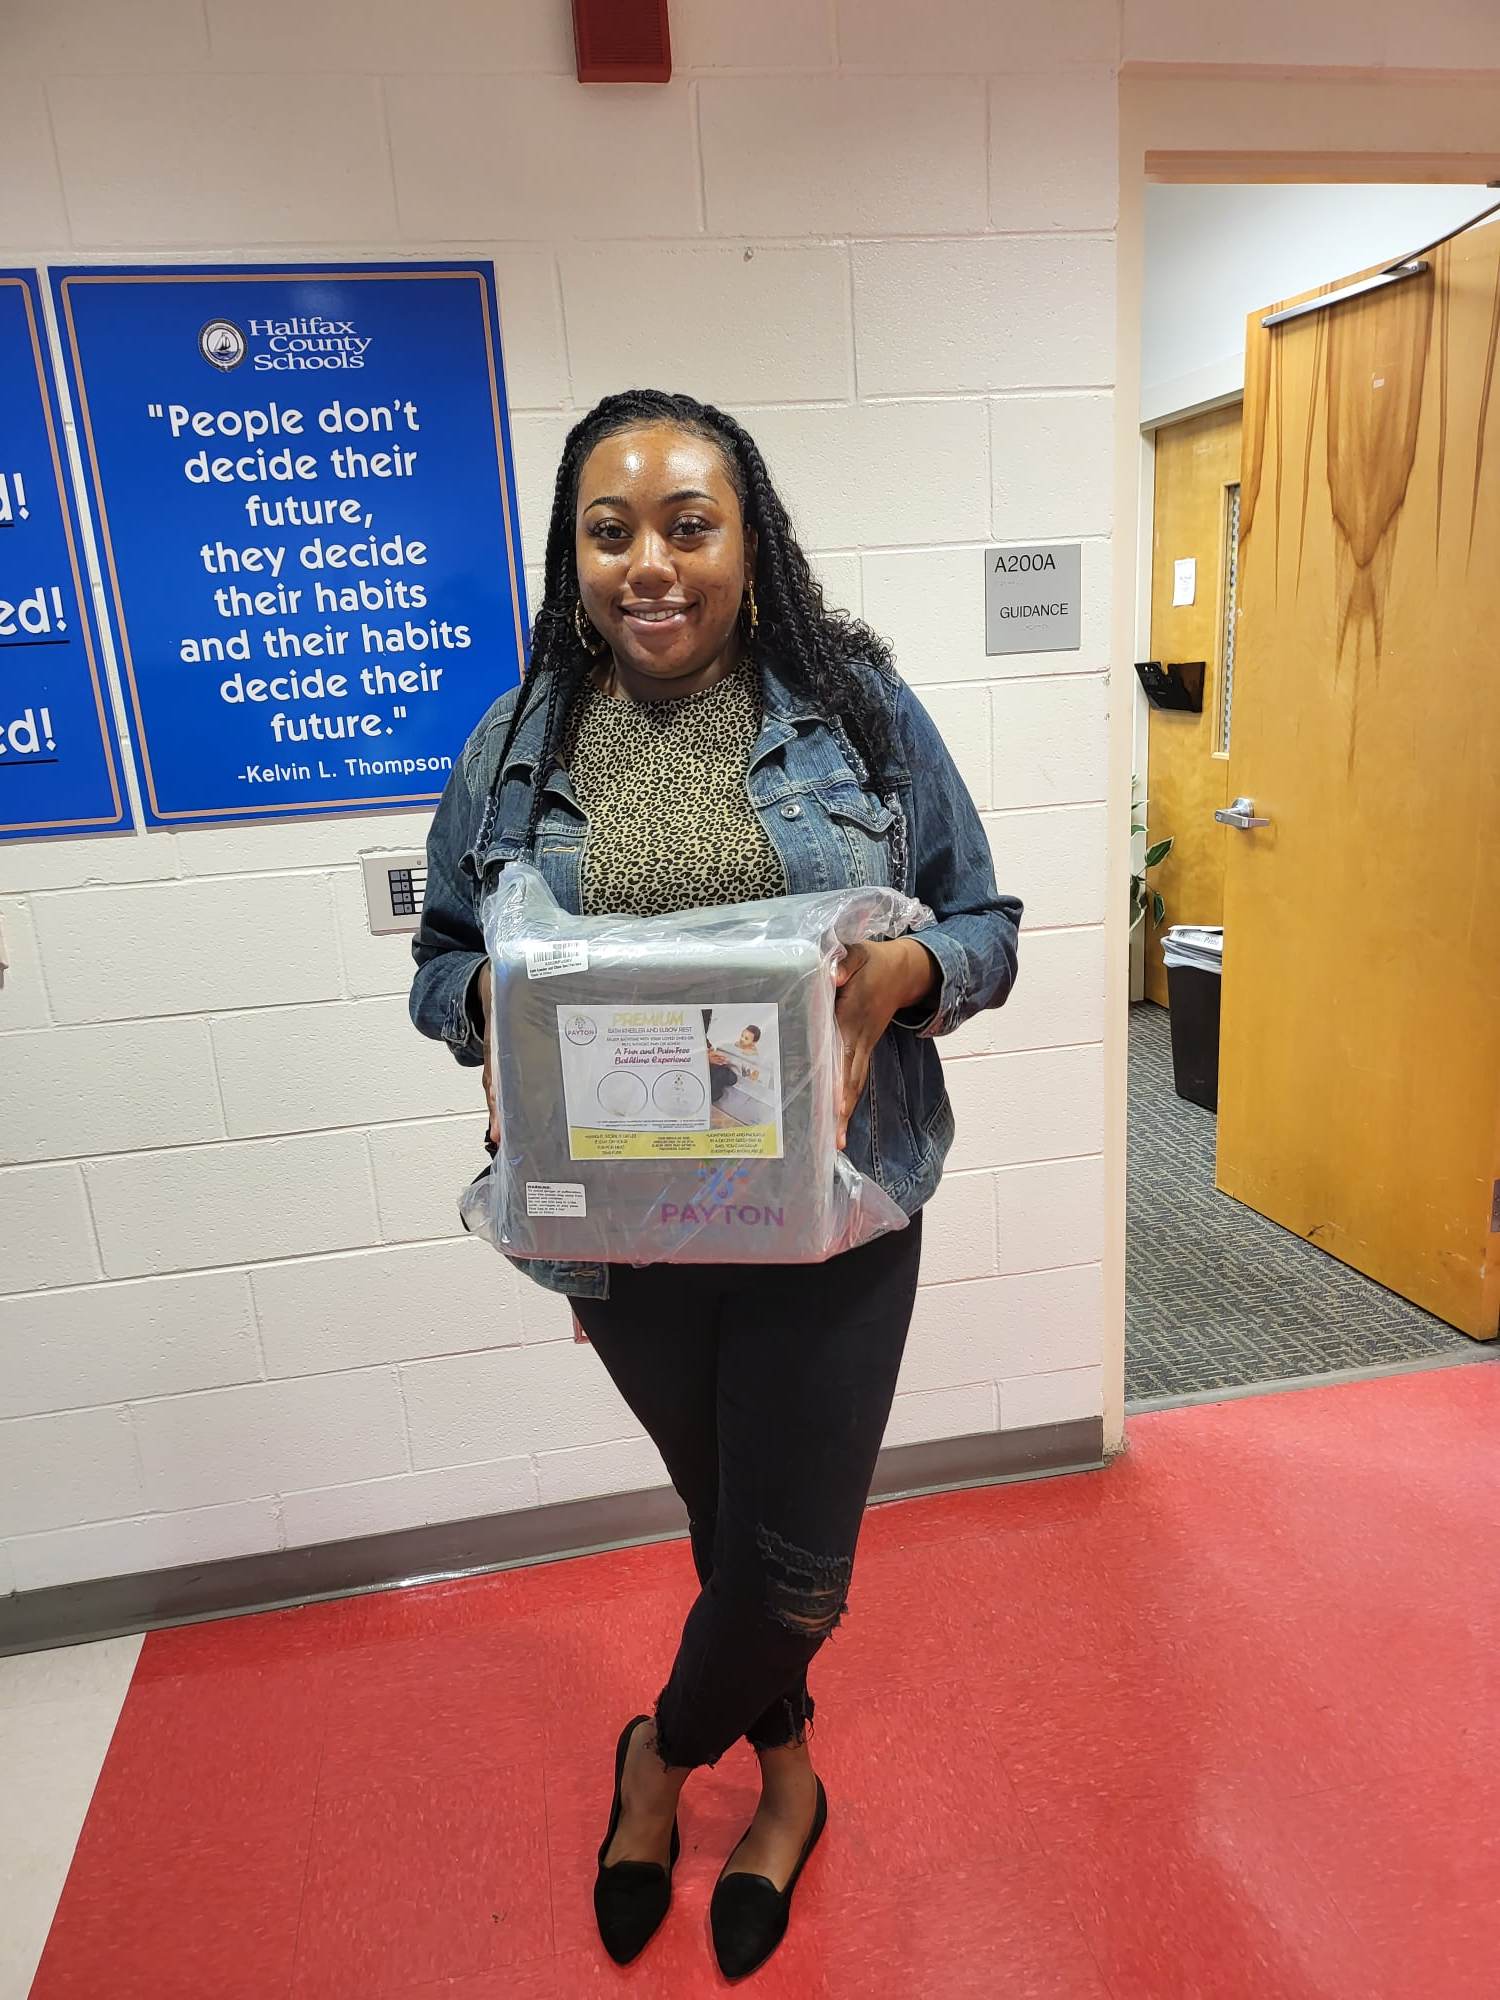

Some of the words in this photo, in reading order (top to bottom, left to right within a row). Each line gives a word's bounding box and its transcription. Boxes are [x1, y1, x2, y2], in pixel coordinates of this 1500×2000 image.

[248, 316, 357, 336] Halifax
[269, 335, 373, 356] County
[253, 351, 365, 371] Schools
[148, 401, 304, 443] "People
[318, 399, 420, 434] don't
[184, 447, 318, 484] decide
[330, 445, 417, 479] their
[245, 495, 374, 530] future,
[200, 541, 286, 578] they
[299, 534, 428, 570] decide
[994, 553, 1056, 573] A200A
[213, 582, 302, 618] their
[314, 578, 428, 613] habits
[1000, 603, 1069, 619] GUIDANCE
[179, 629, 251, 663] and
[262, 624, 349, 659] their
[361, 620, 472, 653] habits
[220, 668, 348, 704] decide
[359, 662, 443, 696] their
[270, 706, 407, 743] future."
[237, 762, 311, 783] -Kelvin
[318, 761, 338, 779] L.
[344, 756, 453, 777] Thompson
[613, 1012, 684, 1026] PREMIUM
[567, 1029, 595, 1037] PAYTON
[614, 1047, 622, 1055] A
[623, 1047, 639, 1055] Fun
[640, 1047, 655, 1055] and
[651, 1055, 692, 1065] Experience
[661, 1203, 785, 1226] PAYTON
